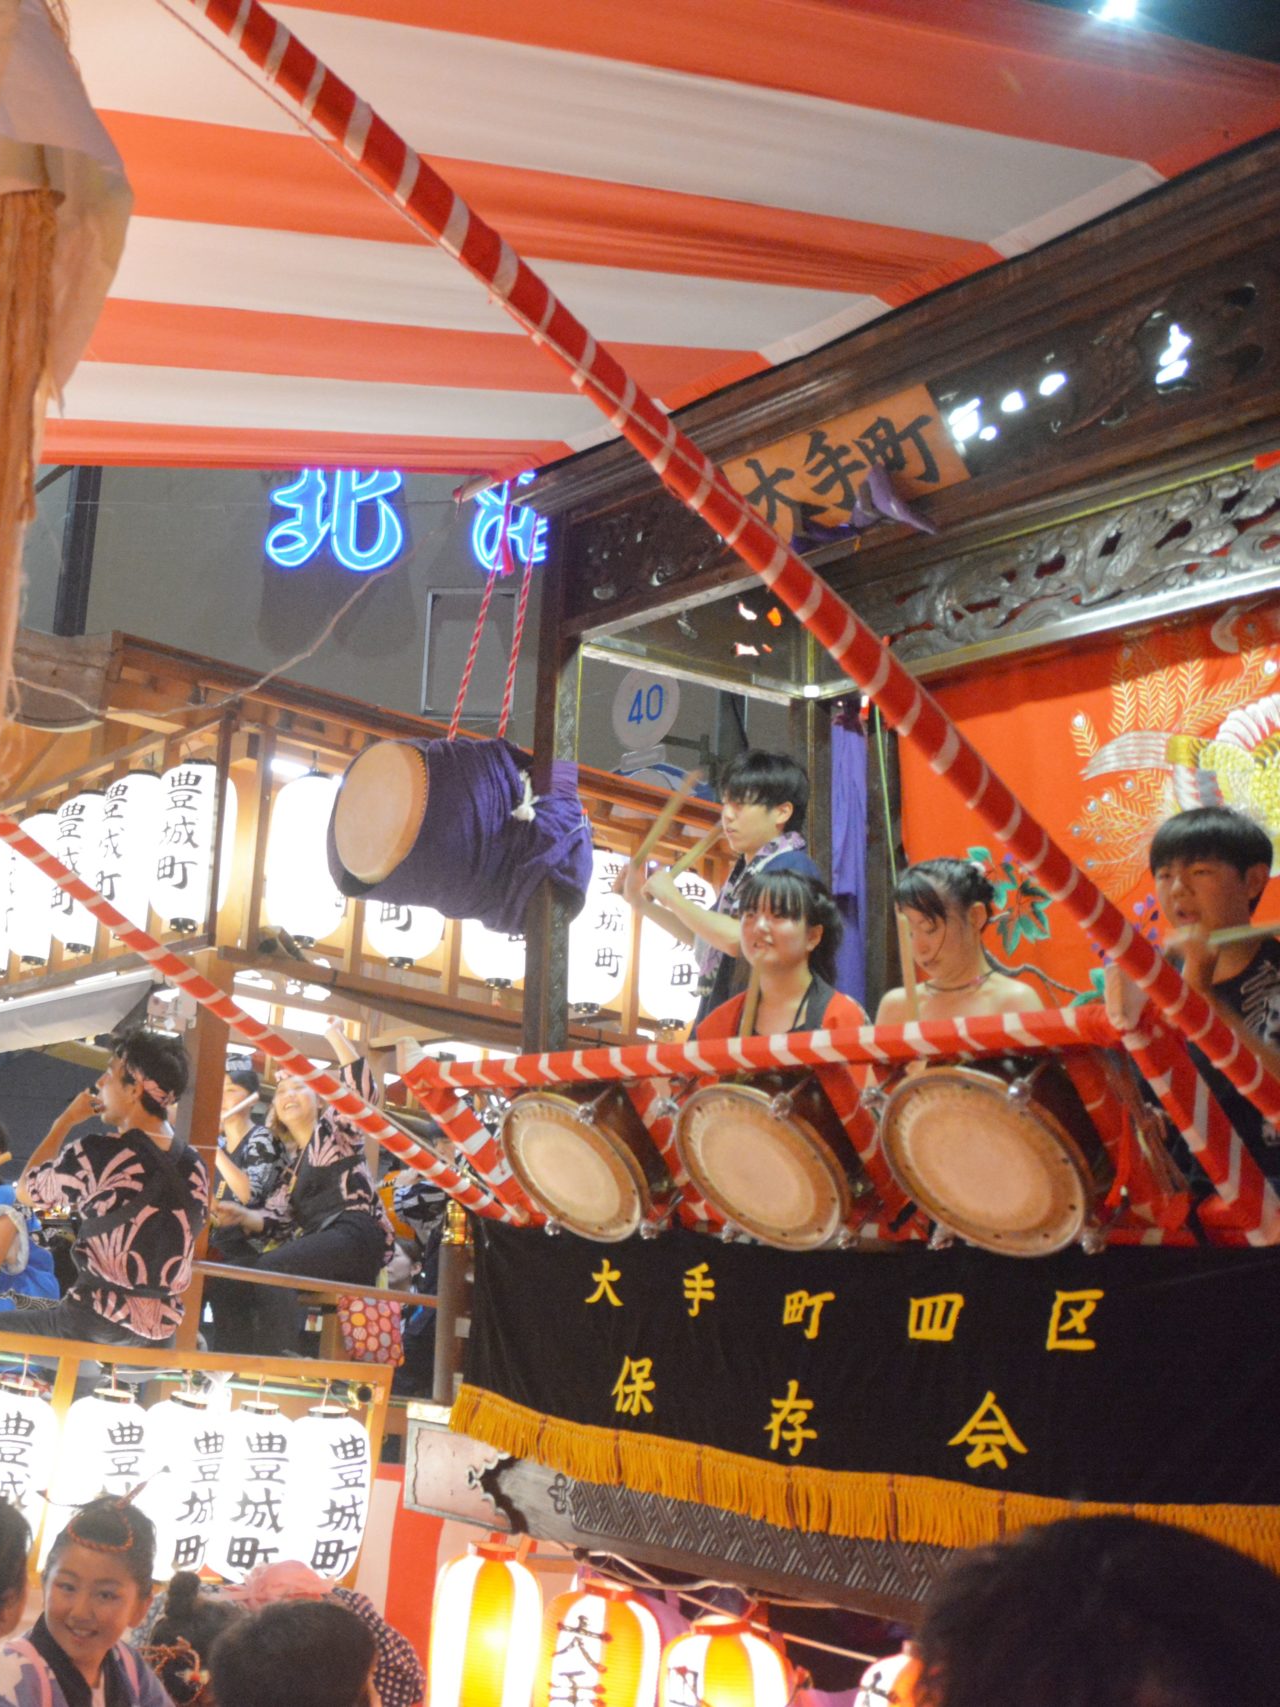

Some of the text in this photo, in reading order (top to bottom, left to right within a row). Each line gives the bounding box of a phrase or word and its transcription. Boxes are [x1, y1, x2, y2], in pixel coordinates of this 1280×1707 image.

[745, 415, 940, 525] 大手町
[628, 684, 664, 724] 40
[157, 771, 202, 889] 豊城町
[586, 1260, 1104, 1351] 大手町四区
[612, 1356, 1028, 1470] 保存会
[175, 1431, 224, 1571] 豊城町
[226, 1431, 290, 1576] 豊城町
[310, 1433, 368, 1578] 豊城町
